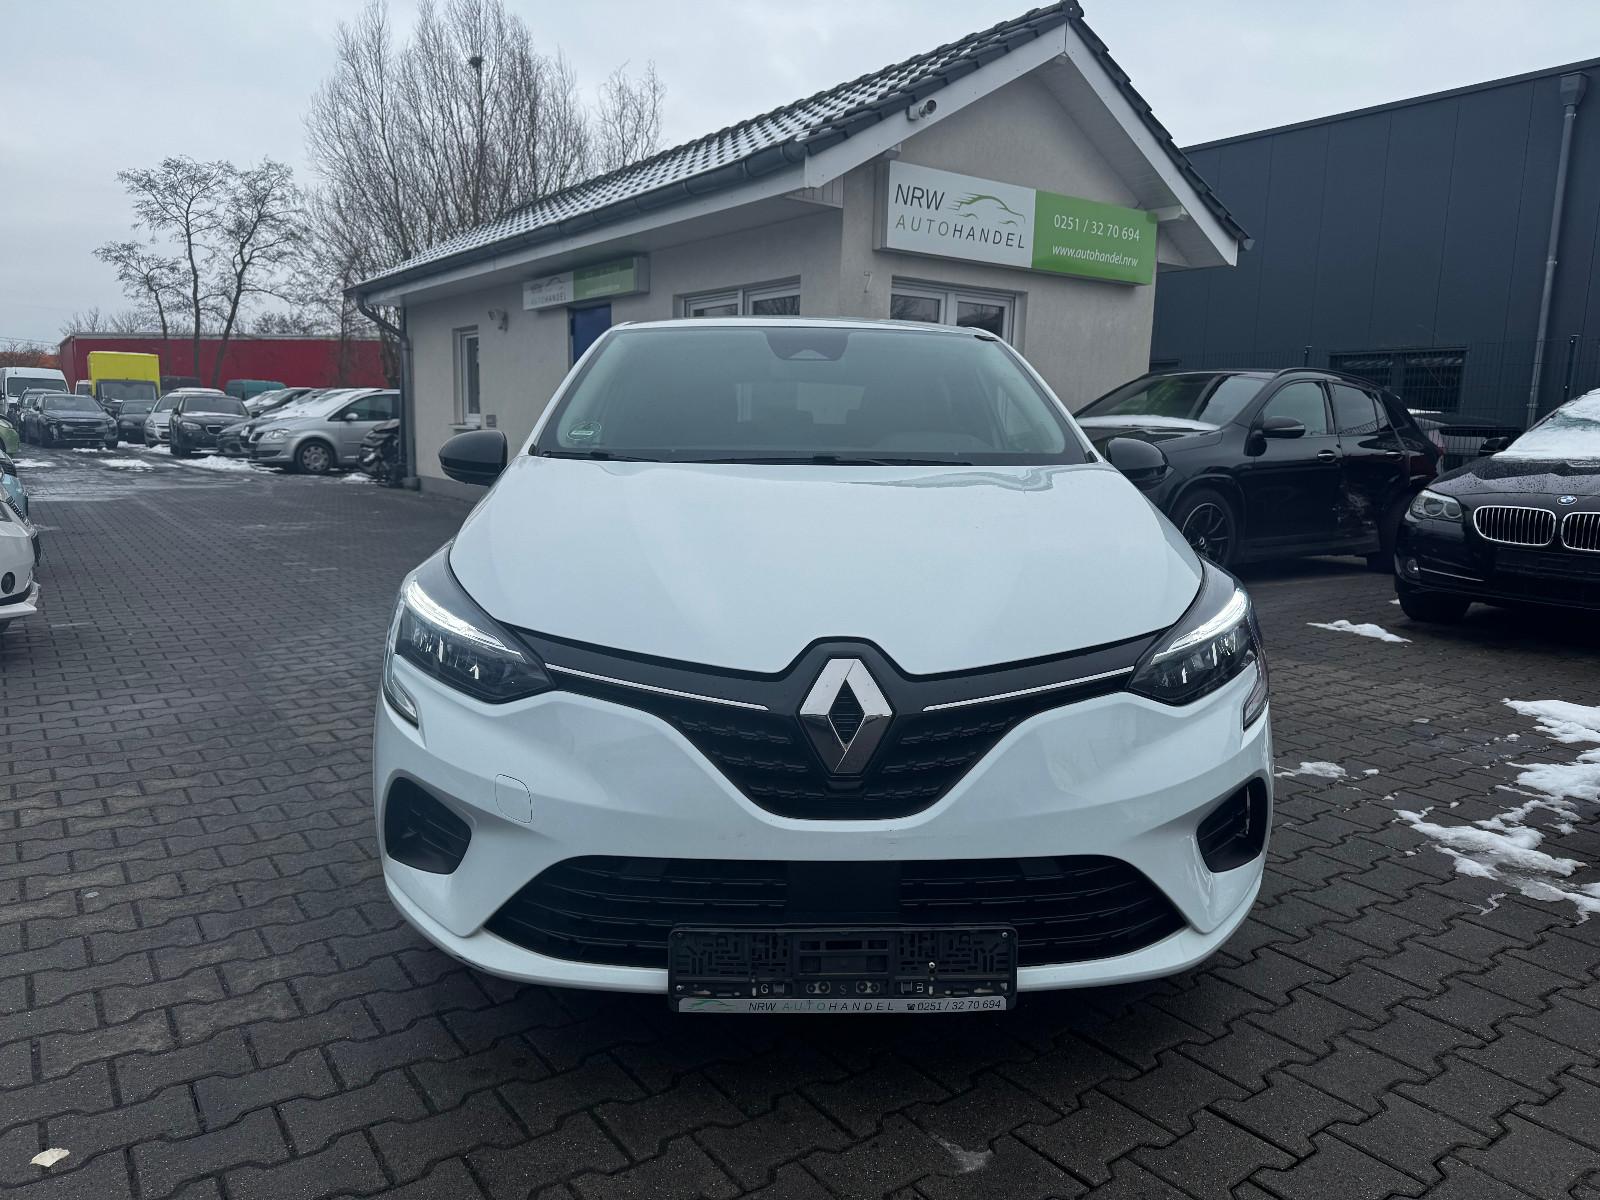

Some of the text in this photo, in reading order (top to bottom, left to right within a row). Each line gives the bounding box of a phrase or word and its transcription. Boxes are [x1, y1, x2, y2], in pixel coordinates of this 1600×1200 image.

[894, 183, 946, 212] NRW
[895, 214, 1026, 249] AUTOHANDEL
[1054, 214, 1140, 241] 0251 / 32 70 694
[1052, 243, 1139, 268] www.autohandel.nrw
[749, 1002, 777, 1012] NRW
[782, 1001, 895, 1012] AUTOHANDEL
[917, 1001, 942, 1011] 0251
[951, 1000, 965, 1010] 32
[967, 1000, 980, 1010] 70
[982, 999, 1001, 1009] 694
